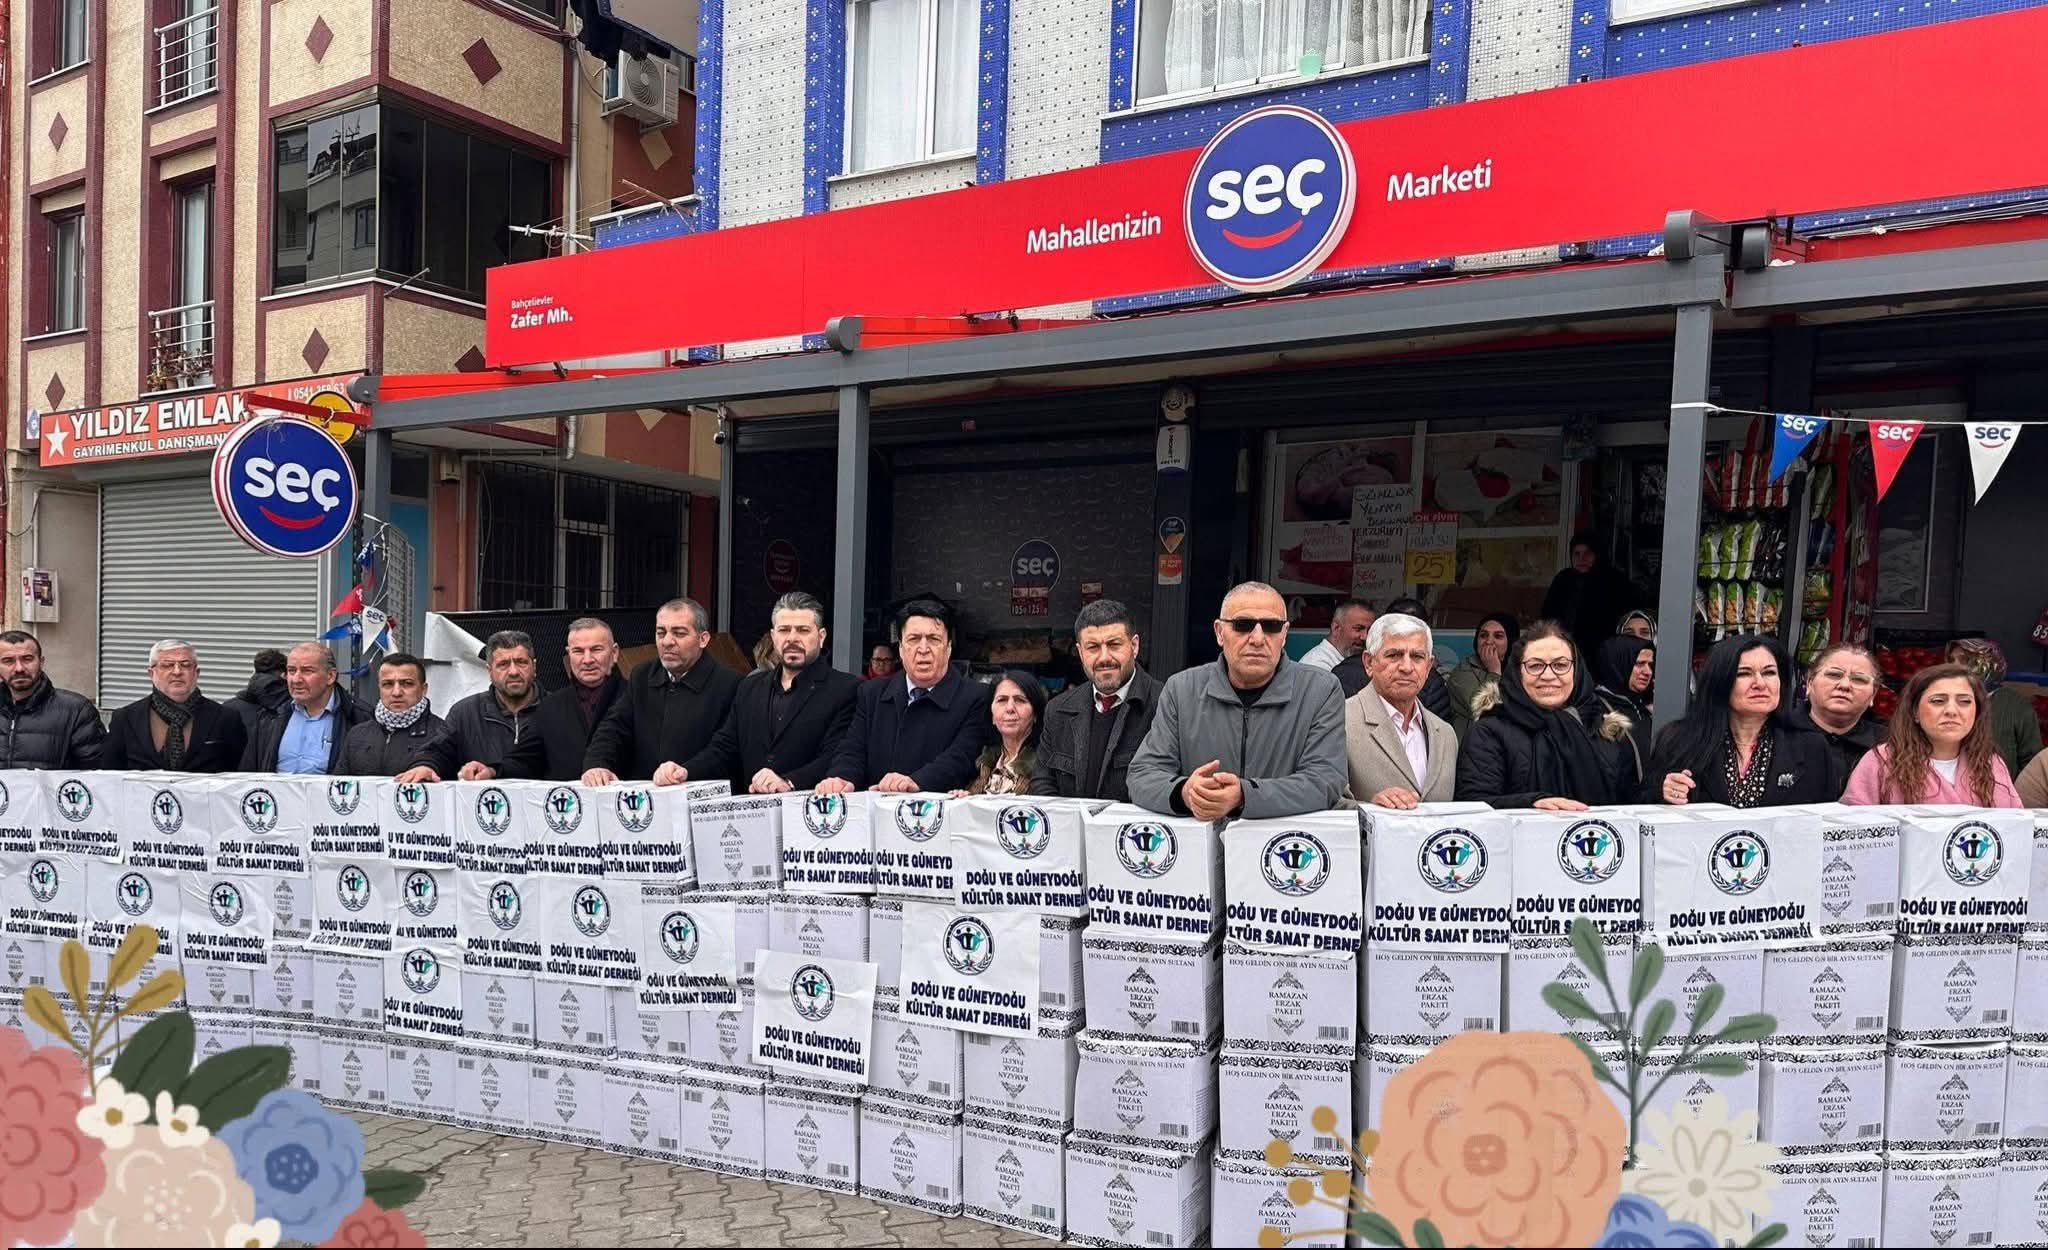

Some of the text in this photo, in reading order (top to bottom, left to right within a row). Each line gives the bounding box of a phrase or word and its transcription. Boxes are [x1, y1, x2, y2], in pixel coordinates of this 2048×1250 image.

[1387, 159, 1493, 202] Marketi
[1206, 157, 1326, 223] seç
[1026, 210, 1162, 254] Mahallenizin
[511, 295, 554, 309] Bahçelievler
[511, 306, 574, 329] Zafer Mh.
[70, 396, 249, 440] YILDIZ EMLAK
[1782, 414, 1818, 434] seç
[1877, 424, 1915, 443] seç
[1974, 425, 2013, 443] seç
[244, 457, 341, 512] seç
[1016, 557, 1055, 577] seç
[1413, 556, 1444, 578] 25
[62, 830, 70, 839] VE
[133, 840, 152, 852] DOĞU
[153, 844, 162, 853] VE
[220, 840, 299, 856] DOĞU VE GÜNEYDOĞU
[620, 843, 630, 854] VE
[632, 841, 681, 855] GÜNEYDOĞU
[129, 855, 156, 867] KÜLTÜR
[179, 859, 208, 872] DERNEĞİ
[217, 857, 304, 872] KÜLTÜR SANAT DERNEĞİ
[626, 861, 651, 872] SANAT
[653, 856, 686, 873] DERNEĞİ
[784, 848, 873, 864] OĞU VE GÜNEYDOĞU
[807, 872, 836, 883] SANAT
[967, 869, 1083, 887] DOĞU VE GÜNEYDOĞU
[962, 889, 1003, 904] KÜLTÜR
[1007, 892, 1041, 905] SANAT
[1089, 886, 1114, 902] OĞU
[1118, 891, 1134, 904] VE
[1517, 894, 1641, 913] DOĞU VE GÜNEYDO
[1376, 903, 1414, 920] DOĞU
[1419, 908, 1436, 921] VE
[1670, 902, 1805, 928] DOĞU VE GÜNEYDOĞU
[1900, 897, 1936, 915] DOĞU
[1941, 901, 1956, 915] VE
[1091, 906, 1120, 924] LTÜR
[1124, 913, 1162, 928] SANAT
[1228, 904, 1361, 930] OĞU VE GÜNEYDOĞ
[1510, 918, 1560, 934] KÜLTÜR
[187, 933, 264, 949] DOĞU VE GÜNEYDOĞU
[1227, 926, 1360, 951] LTÜR SANAT DERNE
[1369, 925, 1510, 943] KÜLTÜR SANAT DERN
[467, 937, 489, 949] DOĞU
[490, 941, 500, 951] VE
[550, 943, 636, 963] DOĞU VE GÜNEYDOĞU
[184, 947, 267, 964] KÜLTÜR SANAT DERNEĞİ
[464, 953, 518, 969] KÜLTÜR SANAT
[547, 962, 641, 981] KÜLTÜR SANAT DERNEĞİ
[911, 981, 1026, 1008] DOĞU VE GÜNEYDOĞU
[1269, 991, 1308, 1000] RAMAZAN
[401, 1002, 411, 1012] VE
[413, 1002, 462, 1021] GÜNEYDOĞU
[906, 1000, 1030, 1030] KÜLTÜR SANAT DERNEĞİ
[404, 1019, 428, 1032] SANAT
[765, 1025, 861, 1054] DOĞU VE GÜNEYDOĞU
[760, 1043, 864, 1075] KÜLTÜR SANAT DERNEĞİ
[1265, 1103, 1303, 1112] RAMAZAN
[1272, 1111, 1297, 1119] ERZAK
